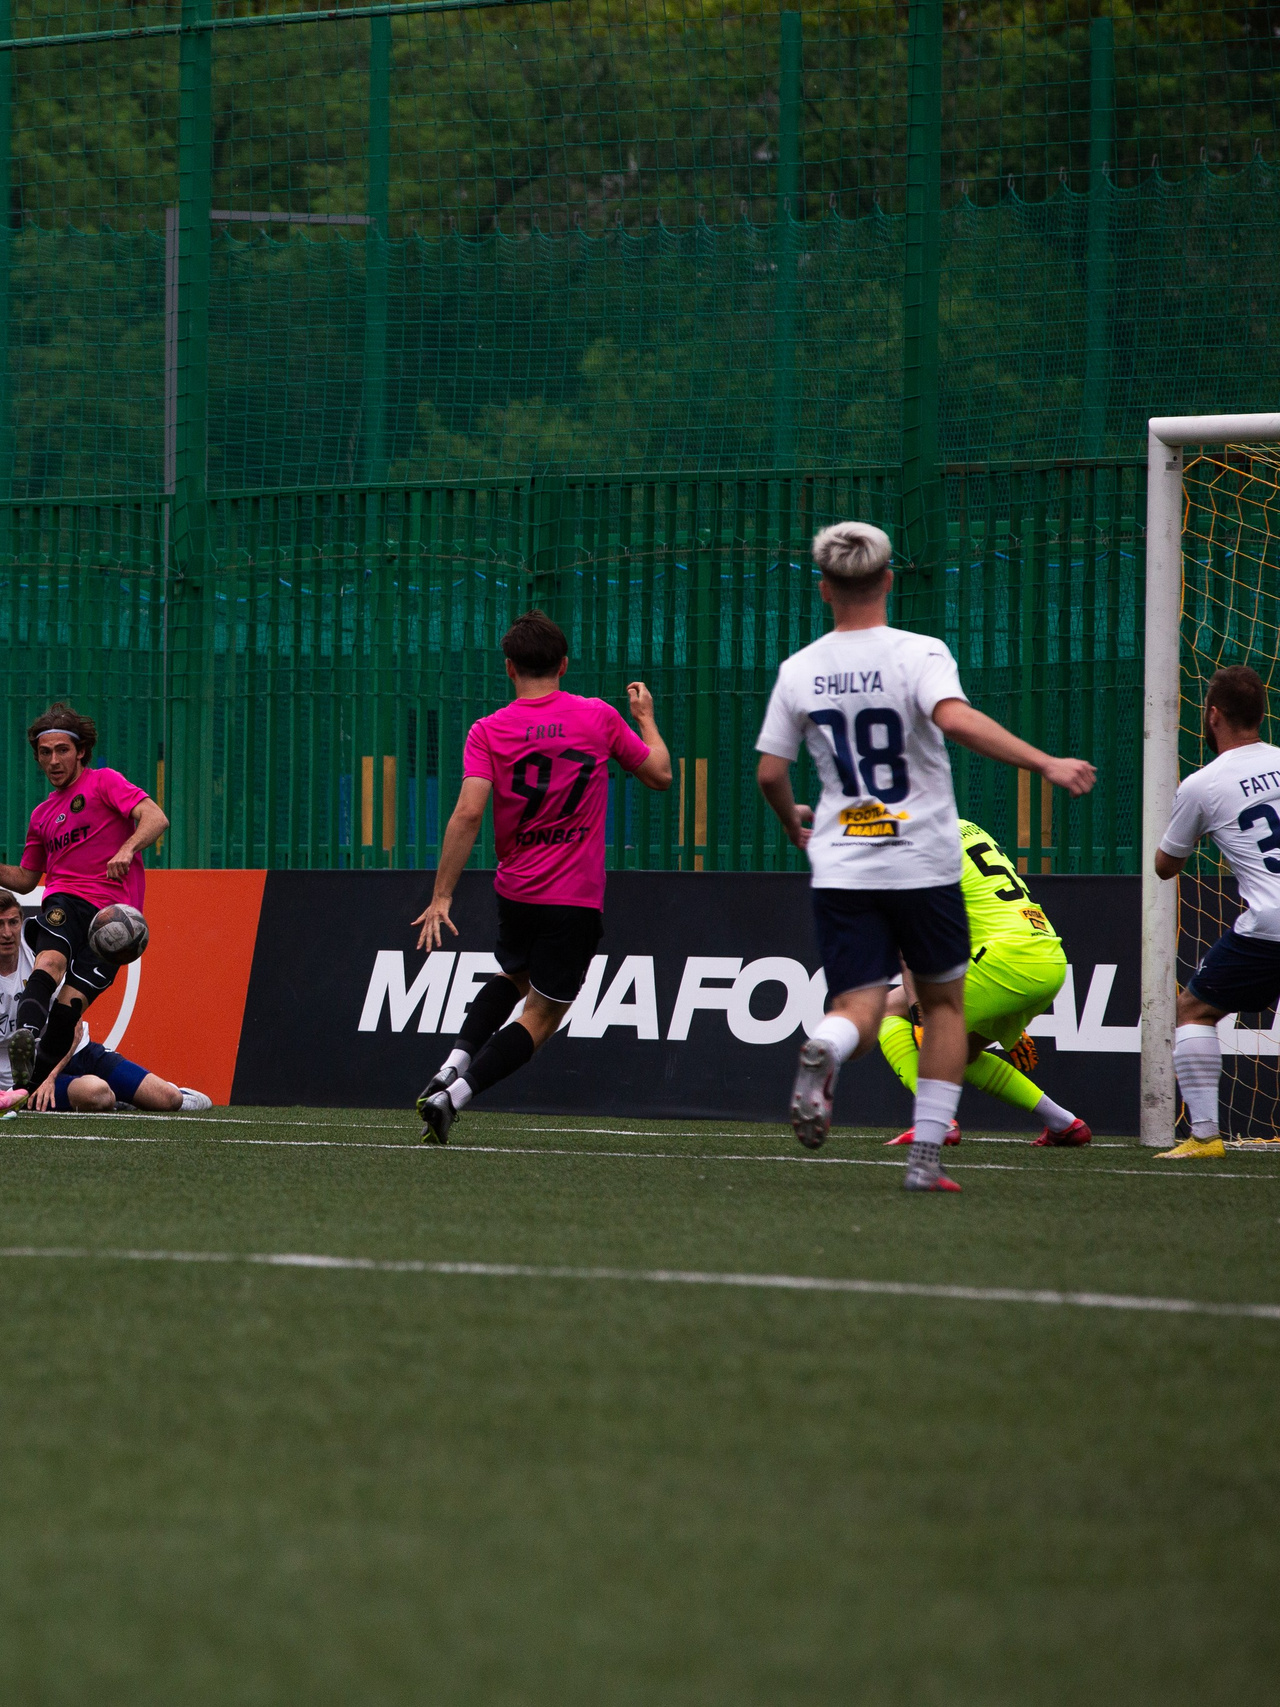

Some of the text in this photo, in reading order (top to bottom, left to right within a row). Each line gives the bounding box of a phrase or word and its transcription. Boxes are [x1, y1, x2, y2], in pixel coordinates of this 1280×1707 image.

[814, 670, 885, 695] SHULYA
[525, 723, 567, 742] FROL
[809, 707, 911, 804] 18
[511, 748, 597, 827] 97
[45, 825, 91, 853] ONBET
[847, 822, 895, 836] MANIA
[966, 842, 1030, 901] 5
[357, 950, 659, 1040] MEIA
